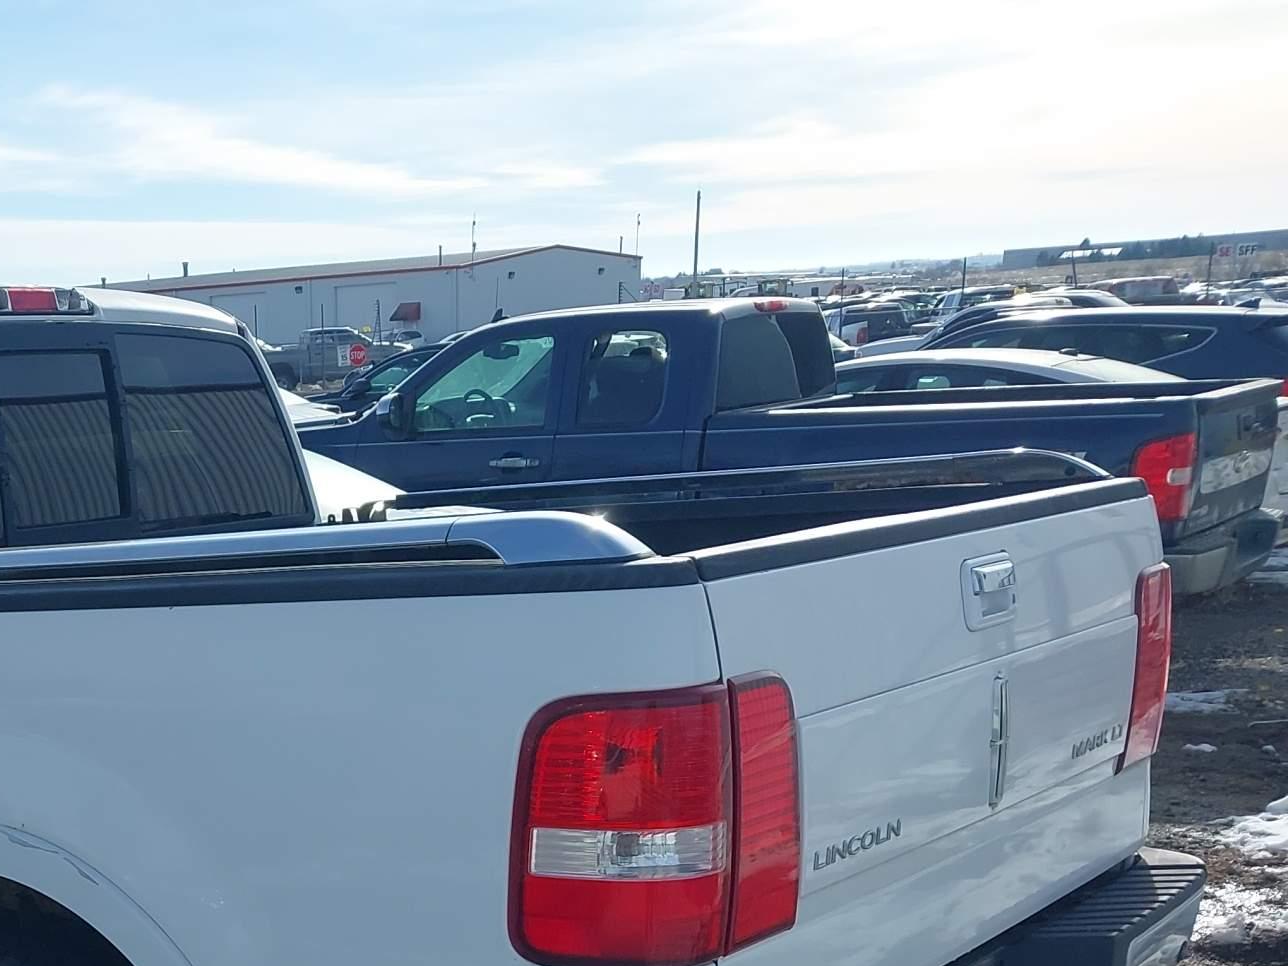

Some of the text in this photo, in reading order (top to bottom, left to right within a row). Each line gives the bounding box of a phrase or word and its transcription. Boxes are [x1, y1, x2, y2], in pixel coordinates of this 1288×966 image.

[350, 351, 366, 361] STOP
[1072, 729, 1109, 760] MARK
[813, 818, 902, 871] LINCOLN
